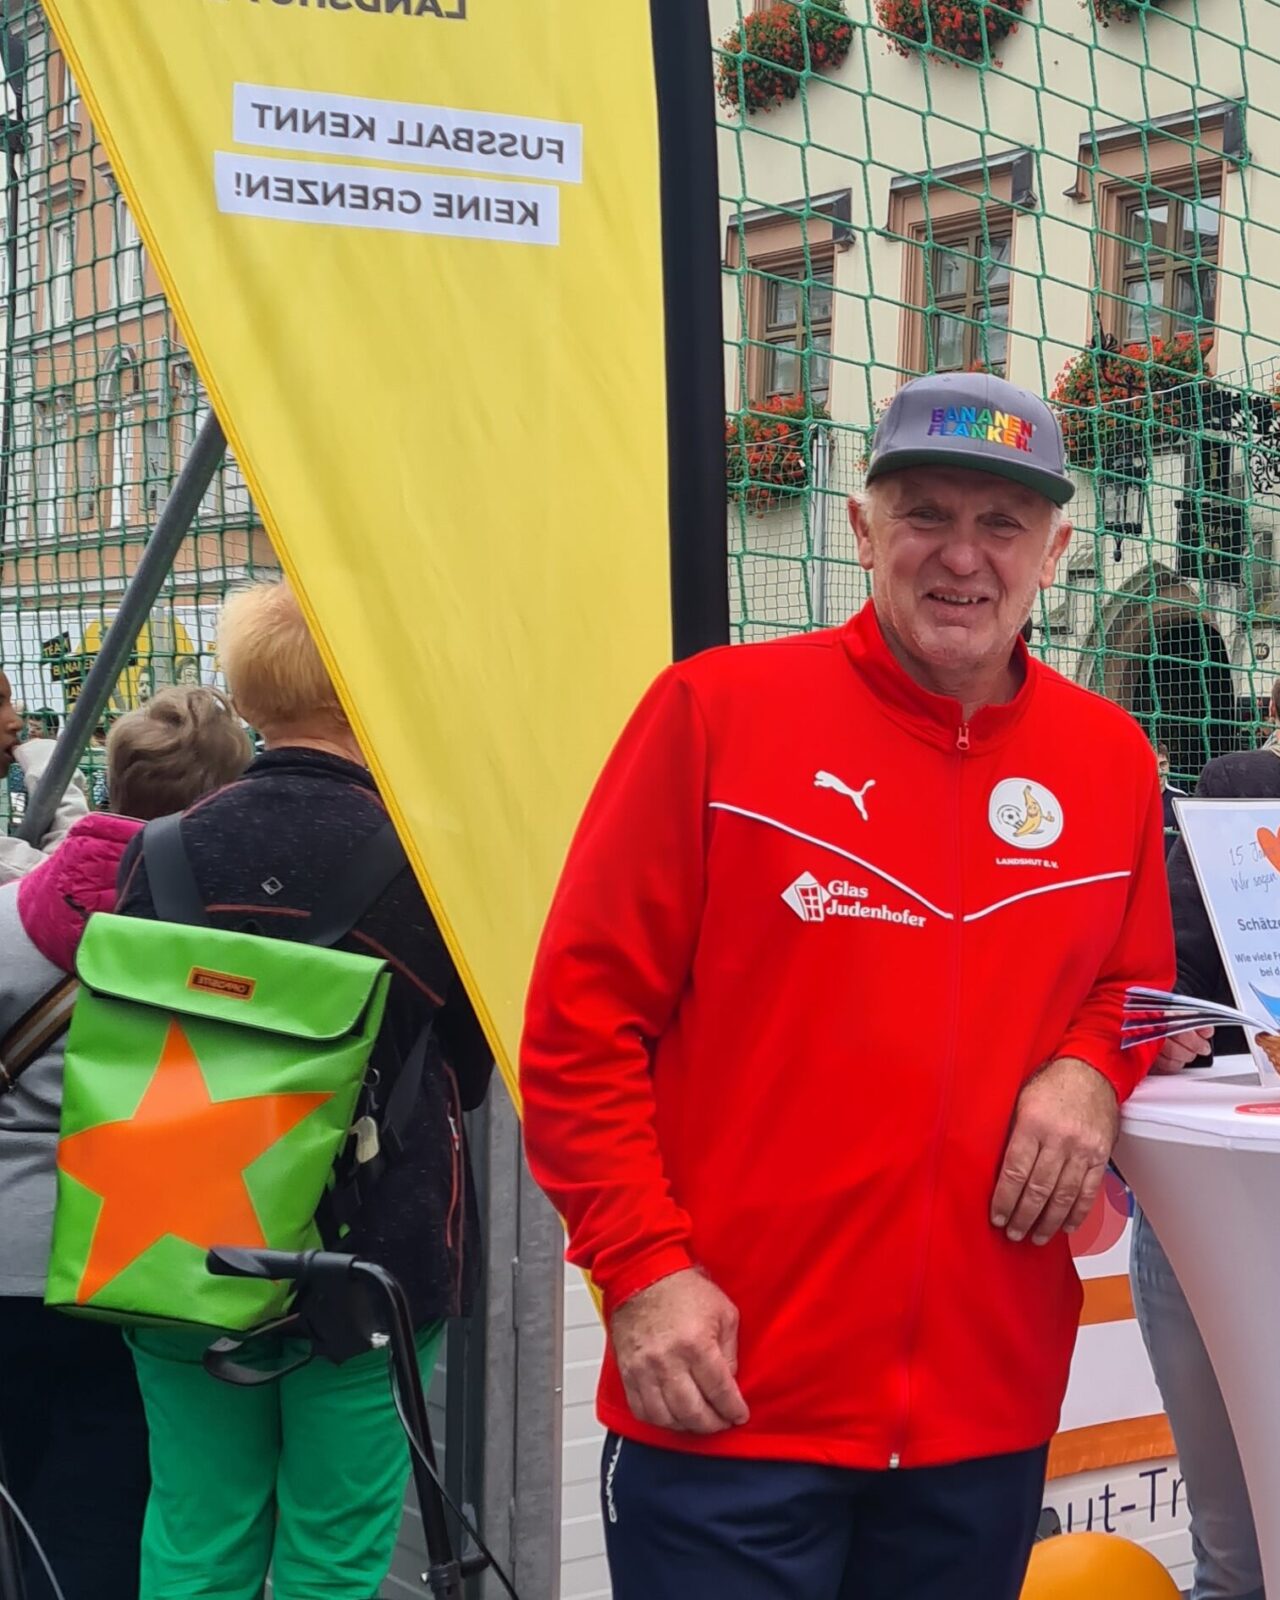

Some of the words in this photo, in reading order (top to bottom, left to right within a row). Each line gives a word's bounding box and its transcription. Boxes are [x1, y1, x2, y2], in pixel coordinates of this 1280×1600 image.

[930, 405, 1033, 439] BANANEN
[1228, 844, 1244, 867] 15
[827, 879, 868, 899] Glas
[825, 898, 927, 928] Judenhofer
[1234, 952, 1252, 963] Wie
[1251, 950, 1273, 962] viele
[1259, 966, 1274, 977] bei
